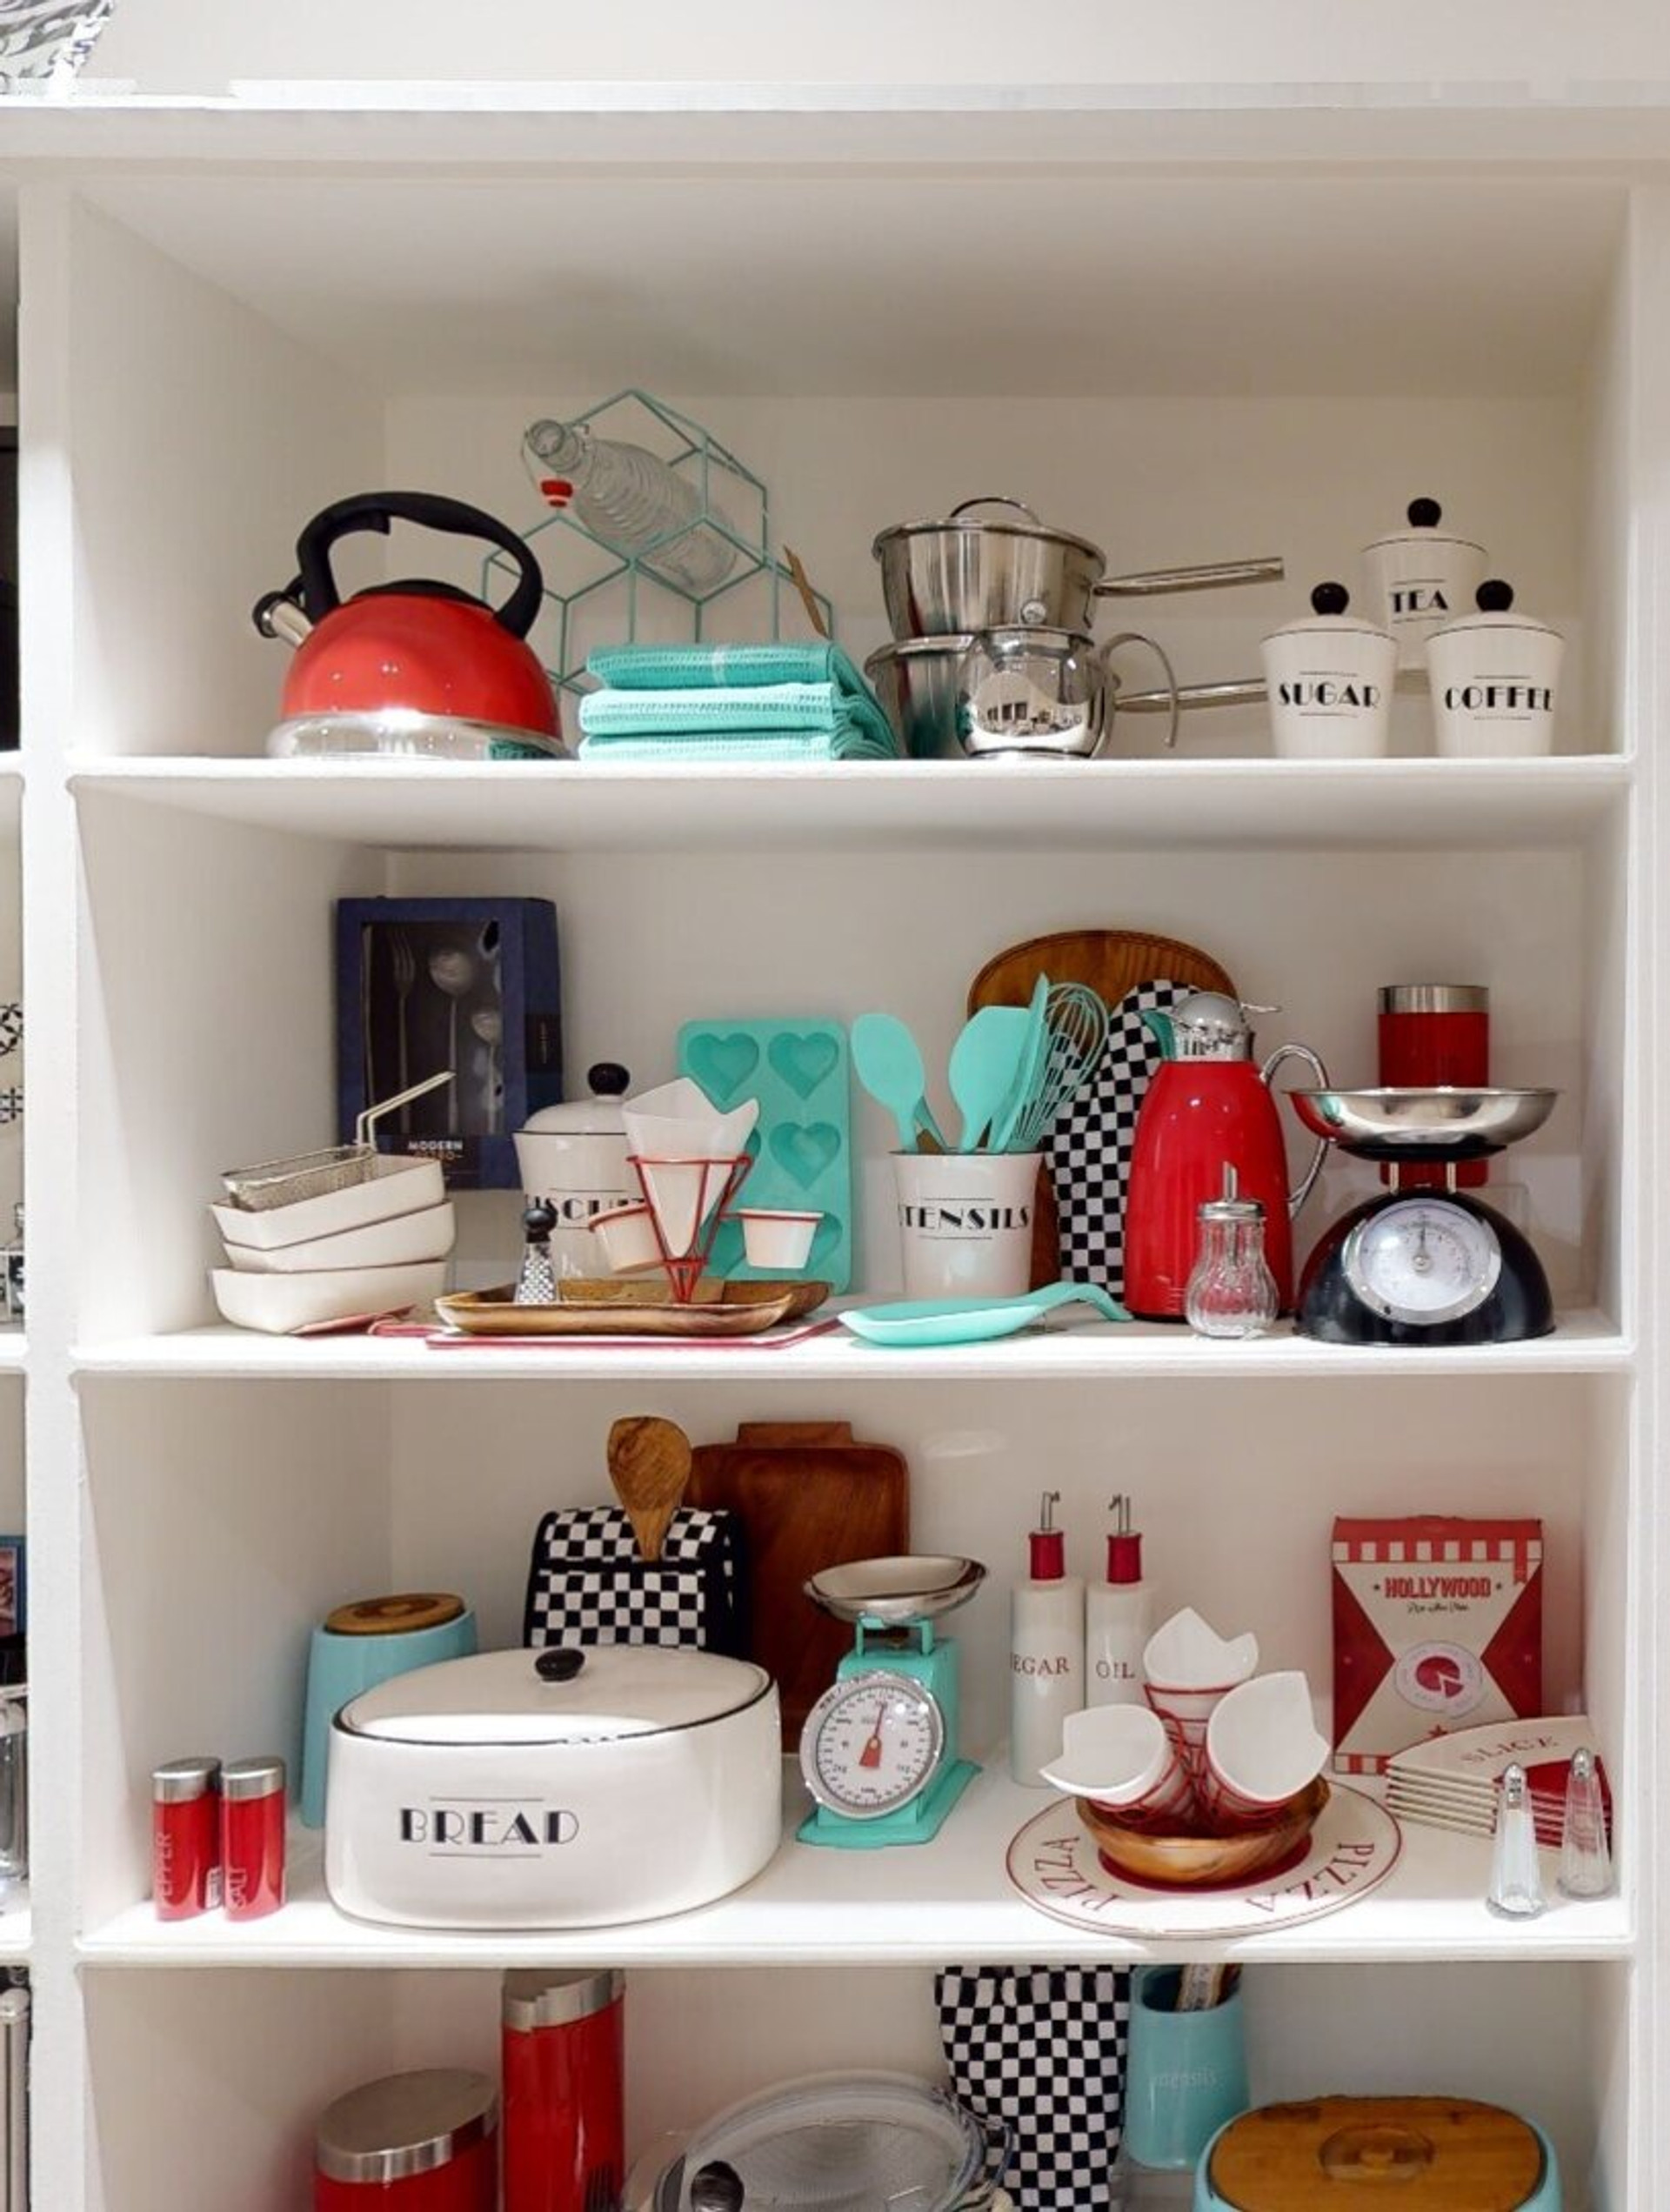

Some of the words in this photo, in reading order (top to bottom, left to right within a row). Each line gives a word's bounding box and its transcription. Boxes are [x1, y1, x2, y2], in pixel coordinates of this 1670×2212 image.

[1389, 589, 1448, 612] TEA
[1278, 681, 1380, 709] SUGAR
[1445, 685, 1553, 712] COFFEE
[898, 1205, 1031, 1230] TENSILS
[1385, 1576, 1492, 1599] HOLLYWOOD
[1010, 1653, 1070, 1676] EGAR
[1095, 1660, 1136, 1680] OIL
[1460, 1736, 1559, 1761] SLICE
[400, 1808, 580, 1845] BREAD
[1033, 1835, 1122, 1911] PIZZA
[1245, 1842, 1375, 1912] PIZZA
